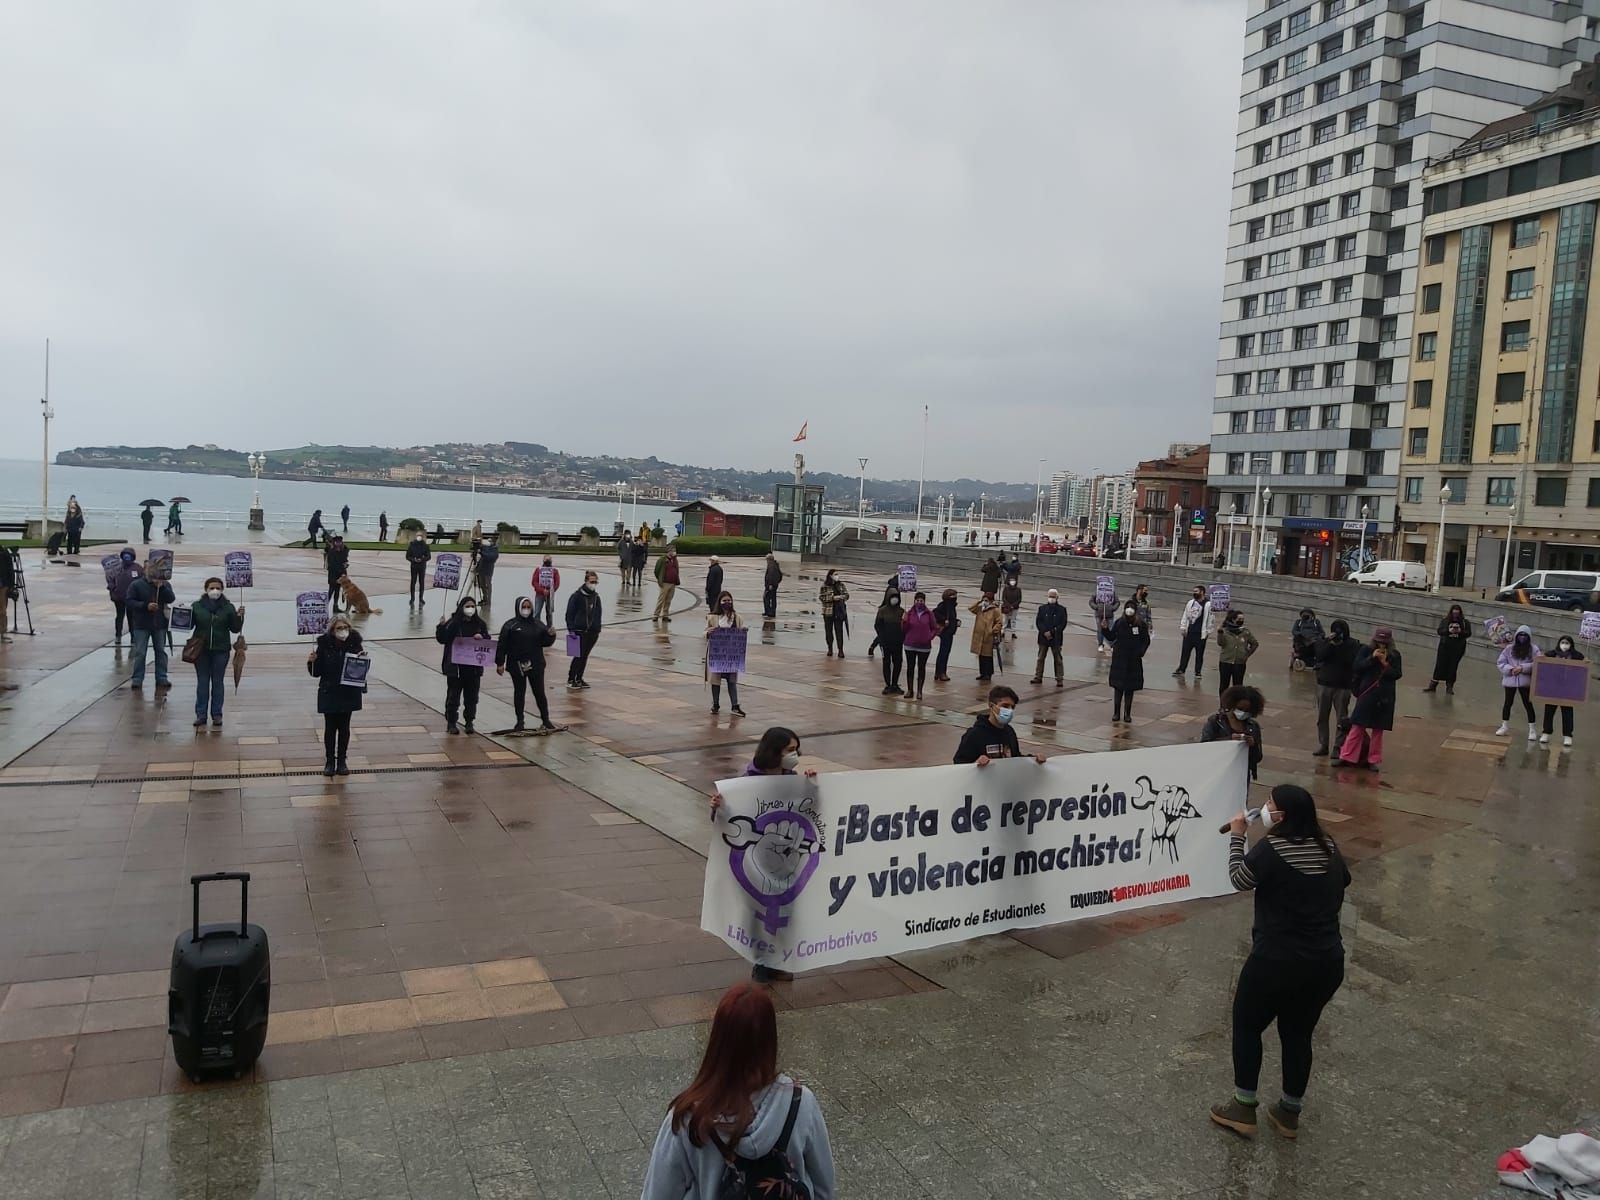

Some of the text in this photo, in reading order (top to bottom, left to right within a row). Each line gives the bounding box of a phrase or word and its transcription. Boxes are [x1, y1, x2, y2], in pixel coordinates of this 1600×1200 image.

[755, 798, 784, 819] Libres
[788, 801, 794, 814] y
[834, 783, 1127, 856] ¡Basta de represión
[828, 828, 1145, 916] y violencia machista!
[1070, 889, 1114, 909] IZQUIERDA
[905, 902, 1047, 936] Sindicato de Estudiantes
[727, 925, 878, 962] Libres y Combativas
